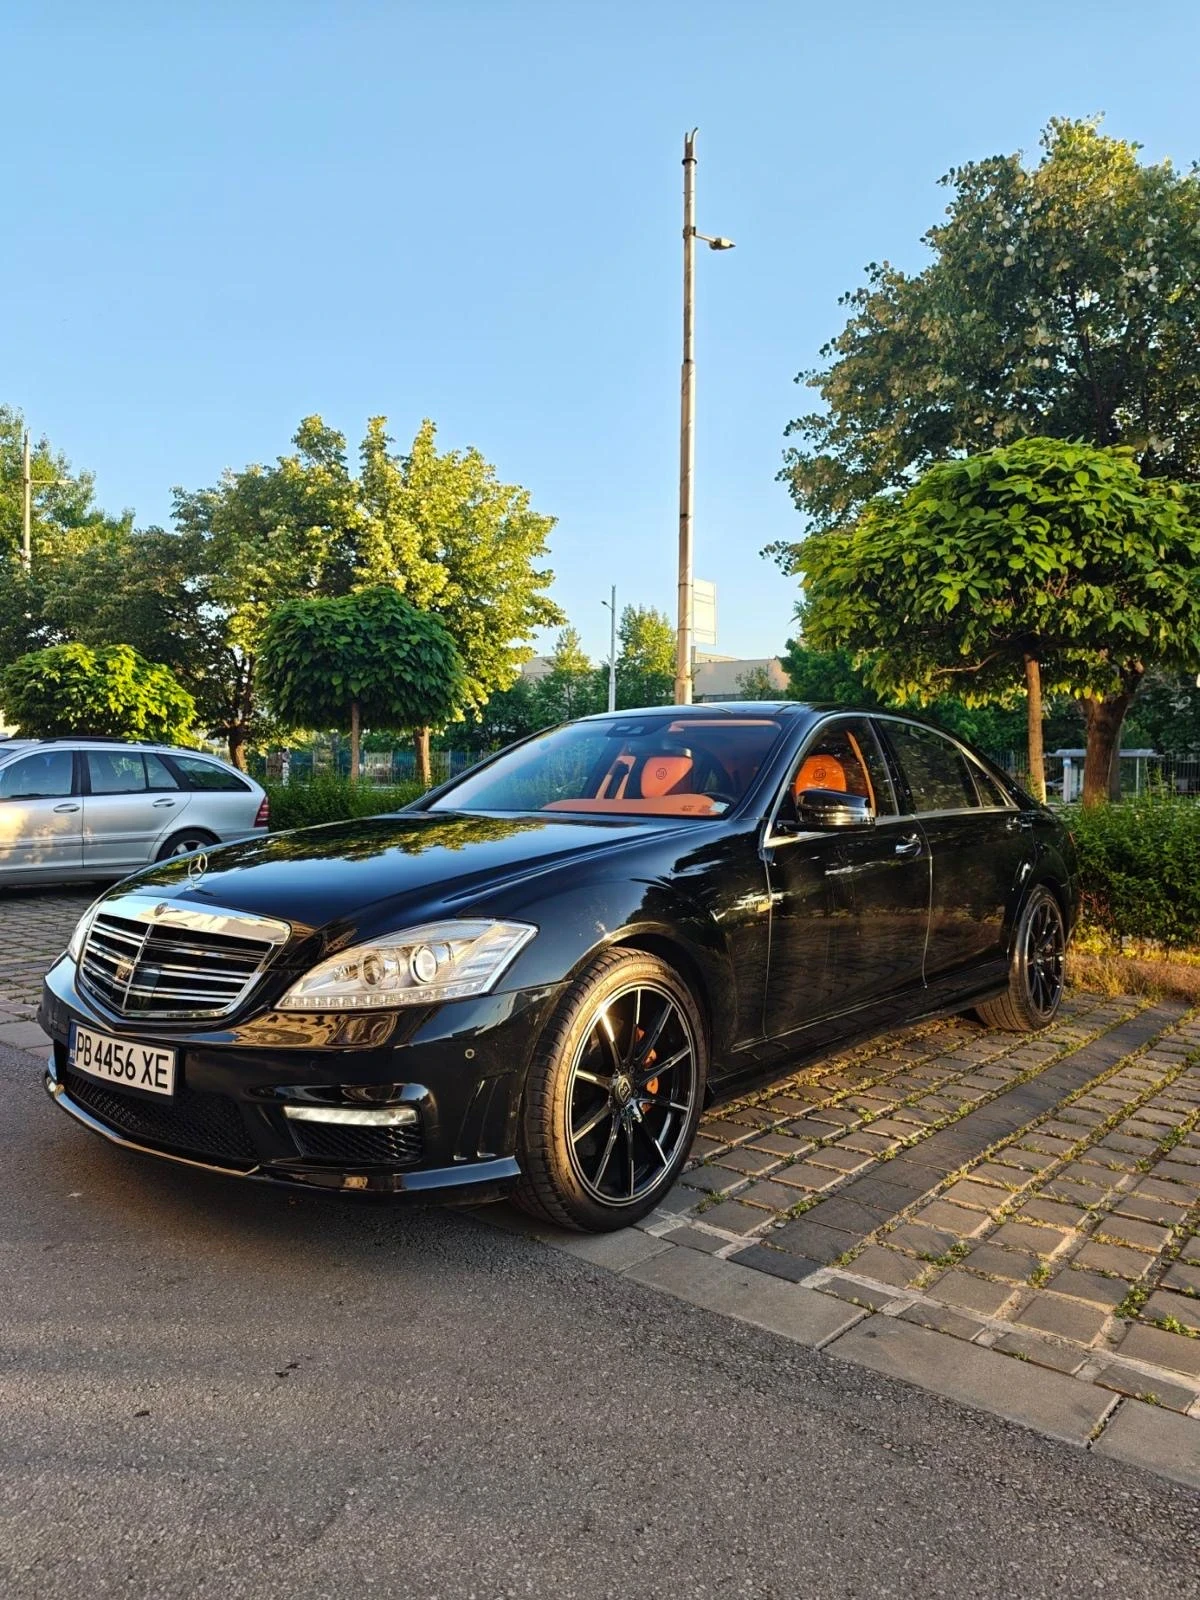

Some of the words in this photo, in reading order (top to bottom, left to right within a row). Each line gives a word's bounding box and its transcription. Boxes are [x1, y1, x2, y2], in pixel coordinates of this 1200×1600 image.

[76, 1031, 92, 1067] PB
[94, 1040, 136, 1081] 4456
[141, 1051, 169, 1089] XE
